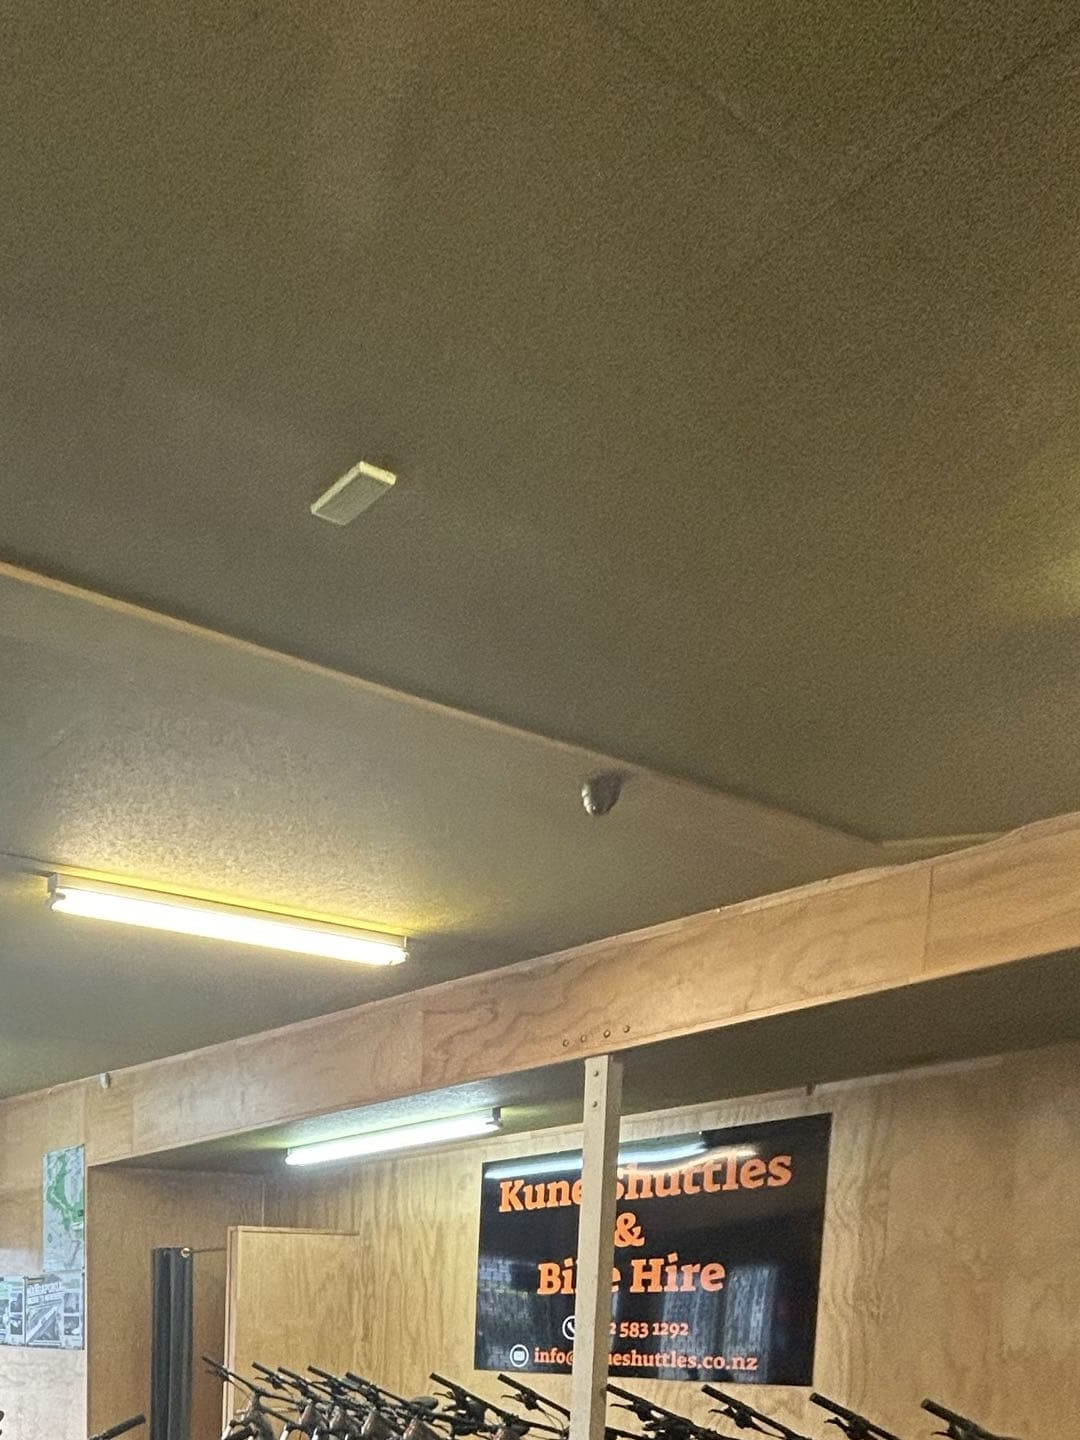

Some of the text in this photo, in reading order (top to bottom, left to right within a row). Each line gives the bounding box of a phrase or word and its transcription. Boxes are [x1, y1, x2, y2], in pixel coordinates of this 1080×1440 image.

[614, 1212, 645, 1248] &
[629, 1252, 725, 1294] Hire
[619, 1322, 649, 1338] 583
[651, 1322, 689, 1338] 1292
